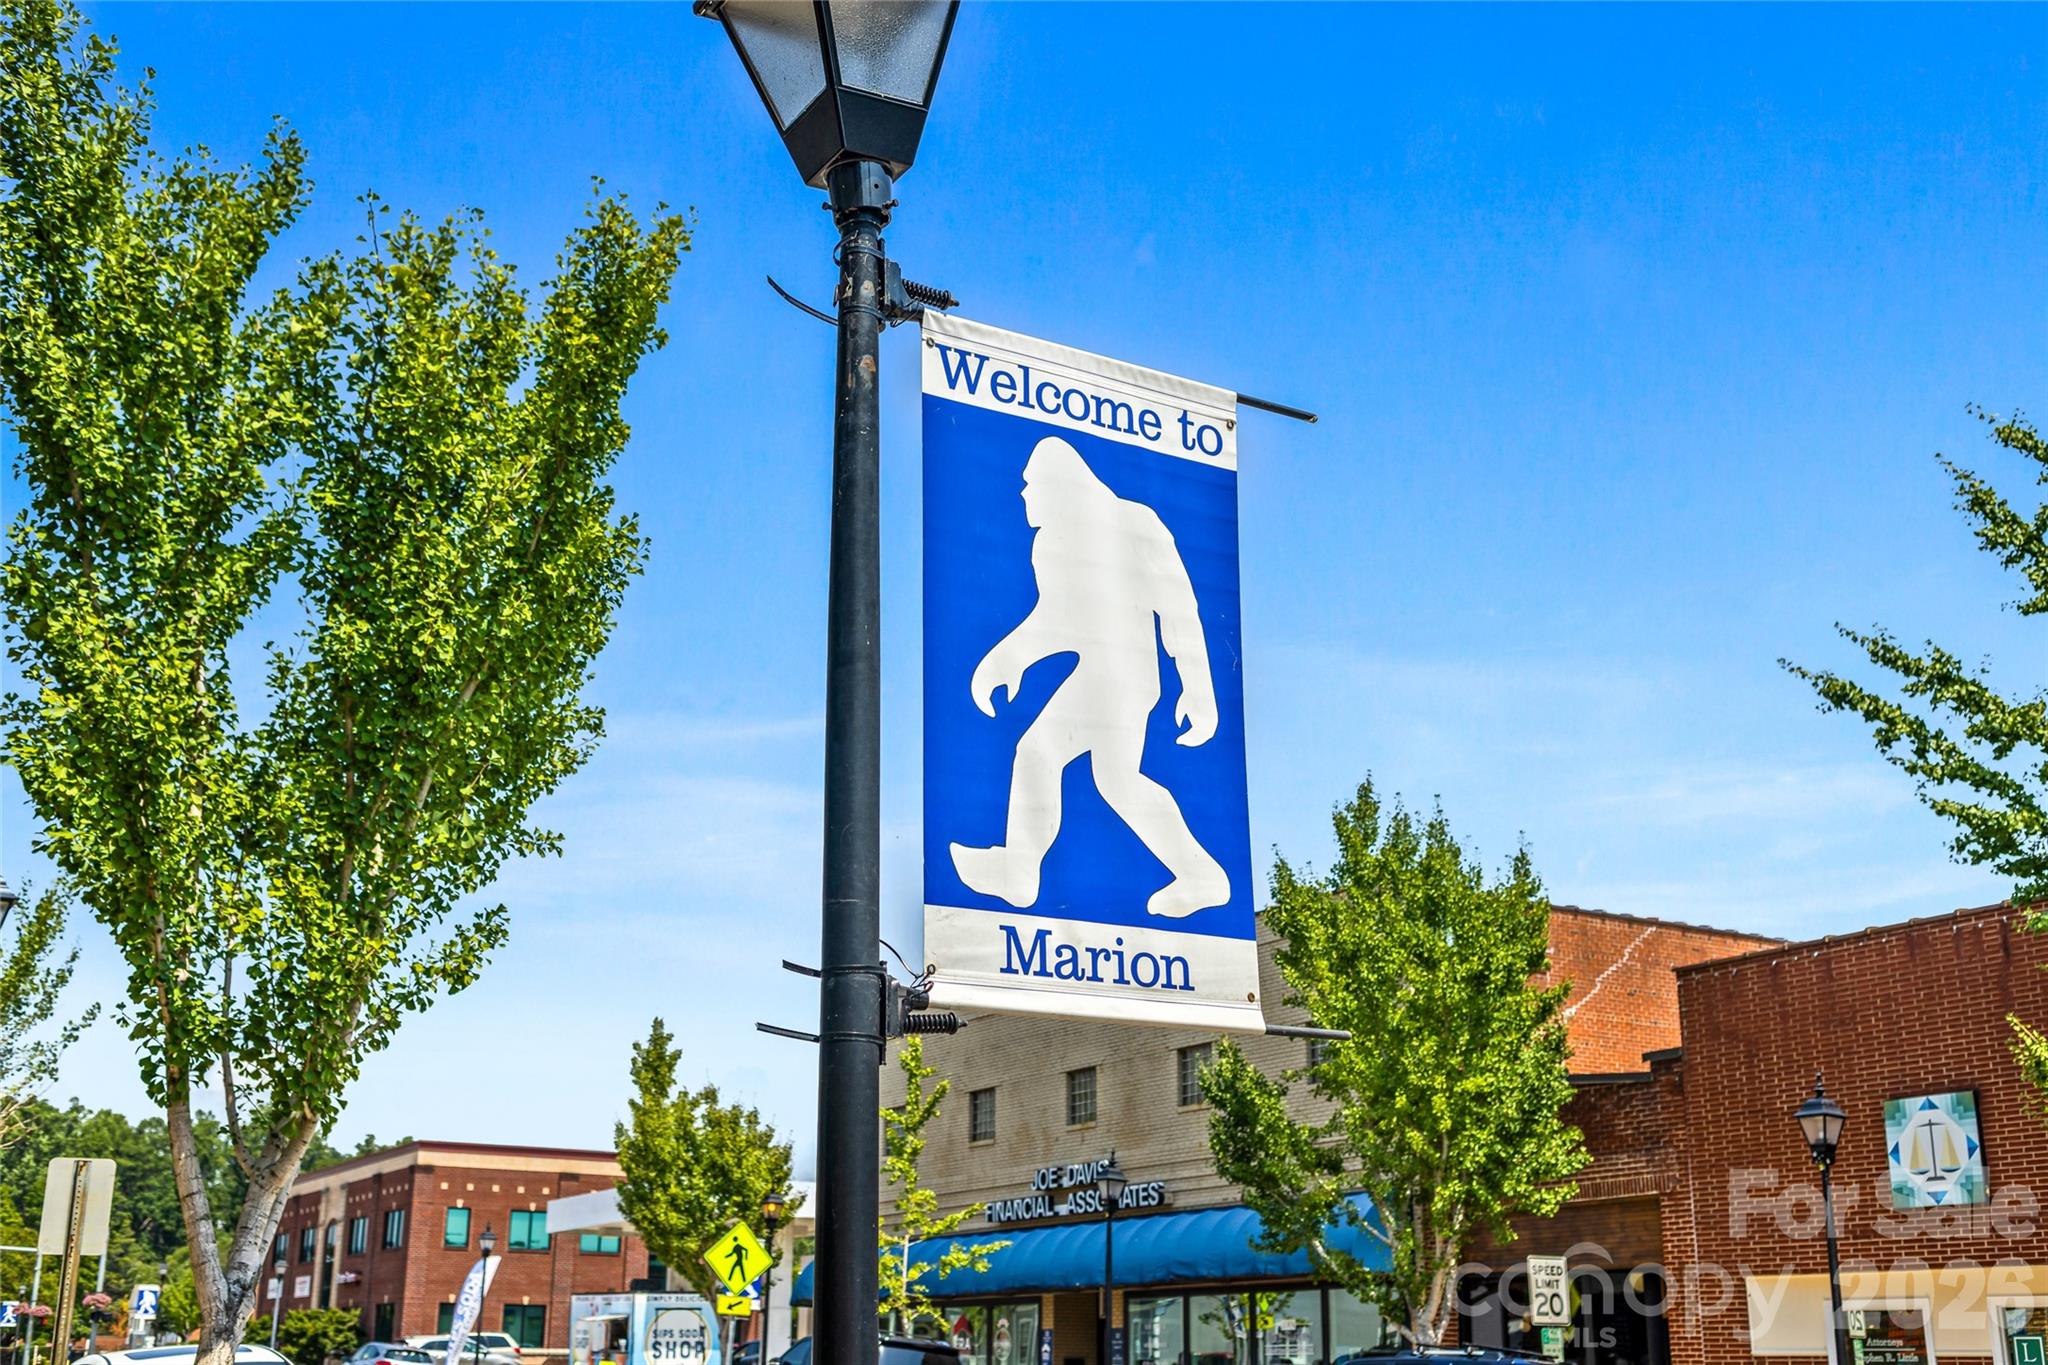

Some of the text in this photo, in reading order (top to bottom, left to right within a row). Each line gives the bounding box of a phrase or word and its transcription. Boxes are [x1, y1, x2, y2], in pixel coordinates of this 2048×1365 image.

[935, 343, 1223, 456] Welcome to
[1000, 925, 1195, 991] Marion
[1031, 1168, 1058, 1190] JOE
[985, 1182, 1160, 1222] FINANCIAL ASSOIATES
[1531, 1264, 1563, 1276] SPEED
[1535, 1279, 1560, 1289] LIMIT
[1535, 1292, 1564, 1317] 20
[652, 1329, 705, 1339] SIPS SODA
[652, 1341, 705, 1359] SHOP
